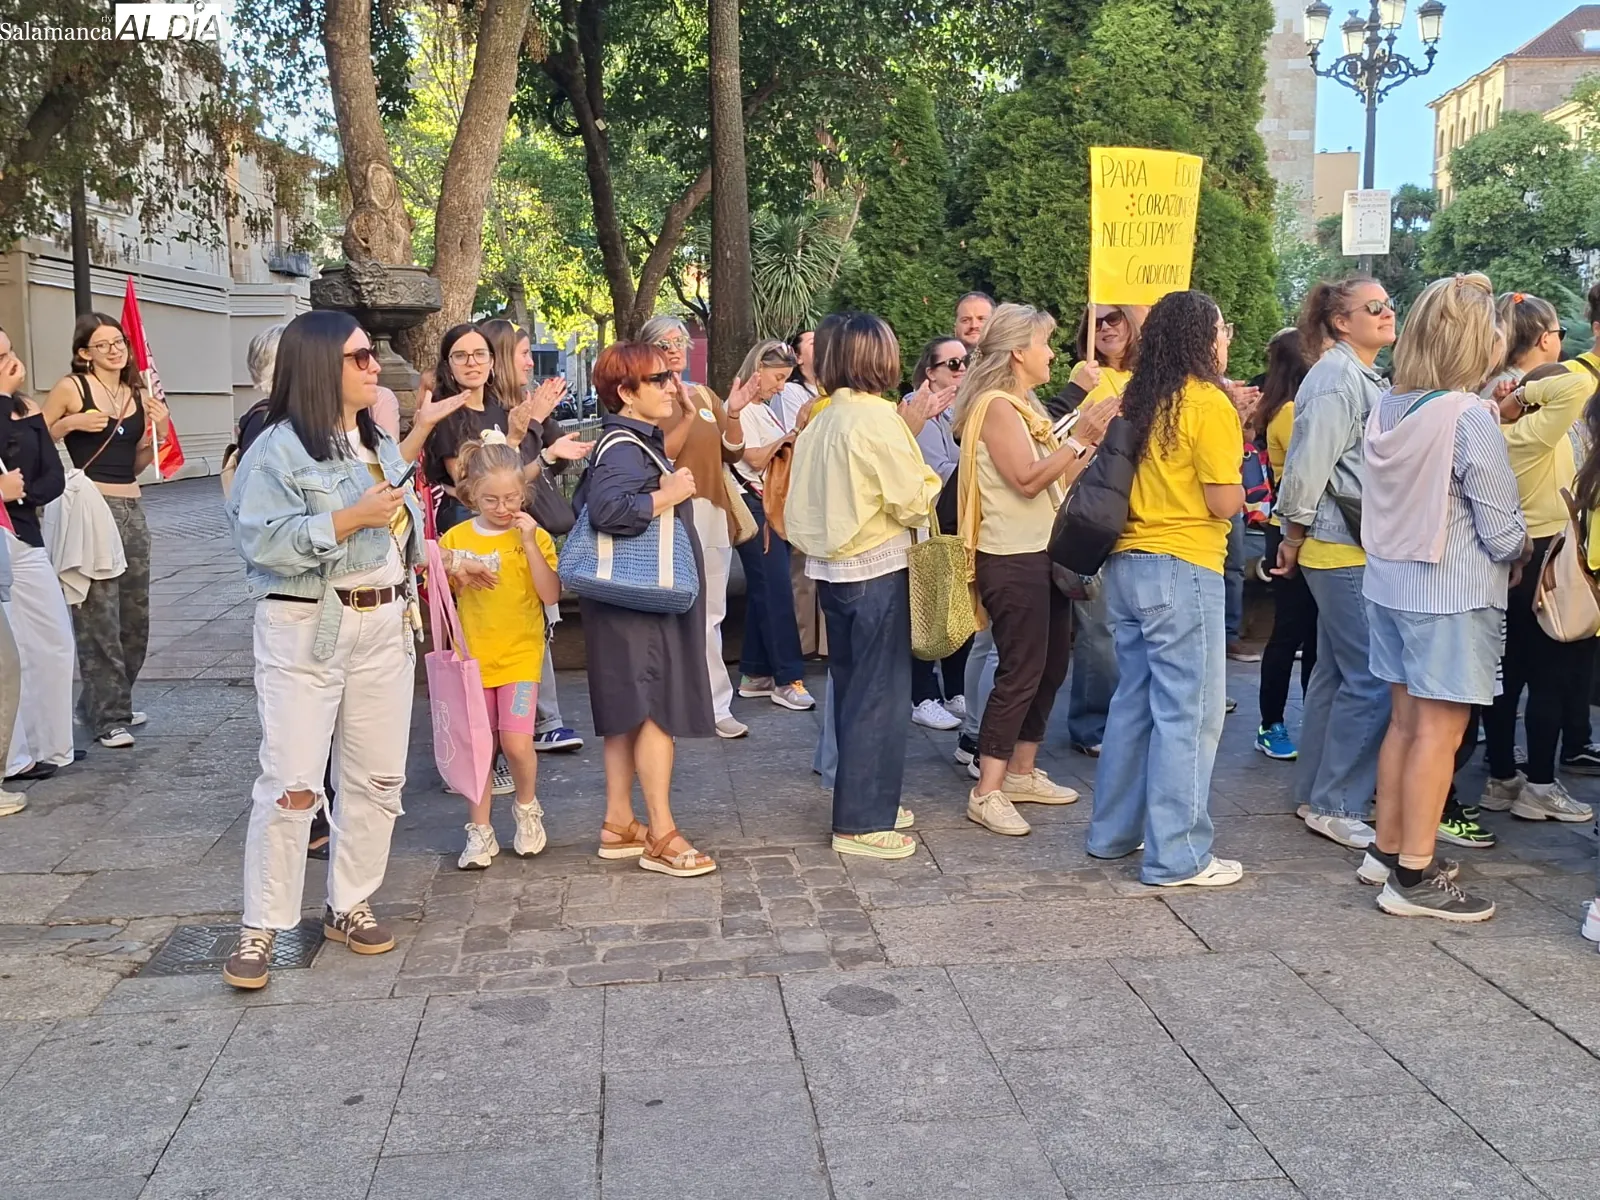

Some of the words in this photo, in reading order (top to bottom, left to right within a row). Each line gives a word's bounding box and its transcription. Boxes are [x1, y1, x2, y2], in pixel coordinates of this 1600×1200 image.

[1100, 154, 1147, 188] PARA
[1137, 192, 1193, 219] CORAZONES
[1125, 254, 1185, 286] CONDICIONES
